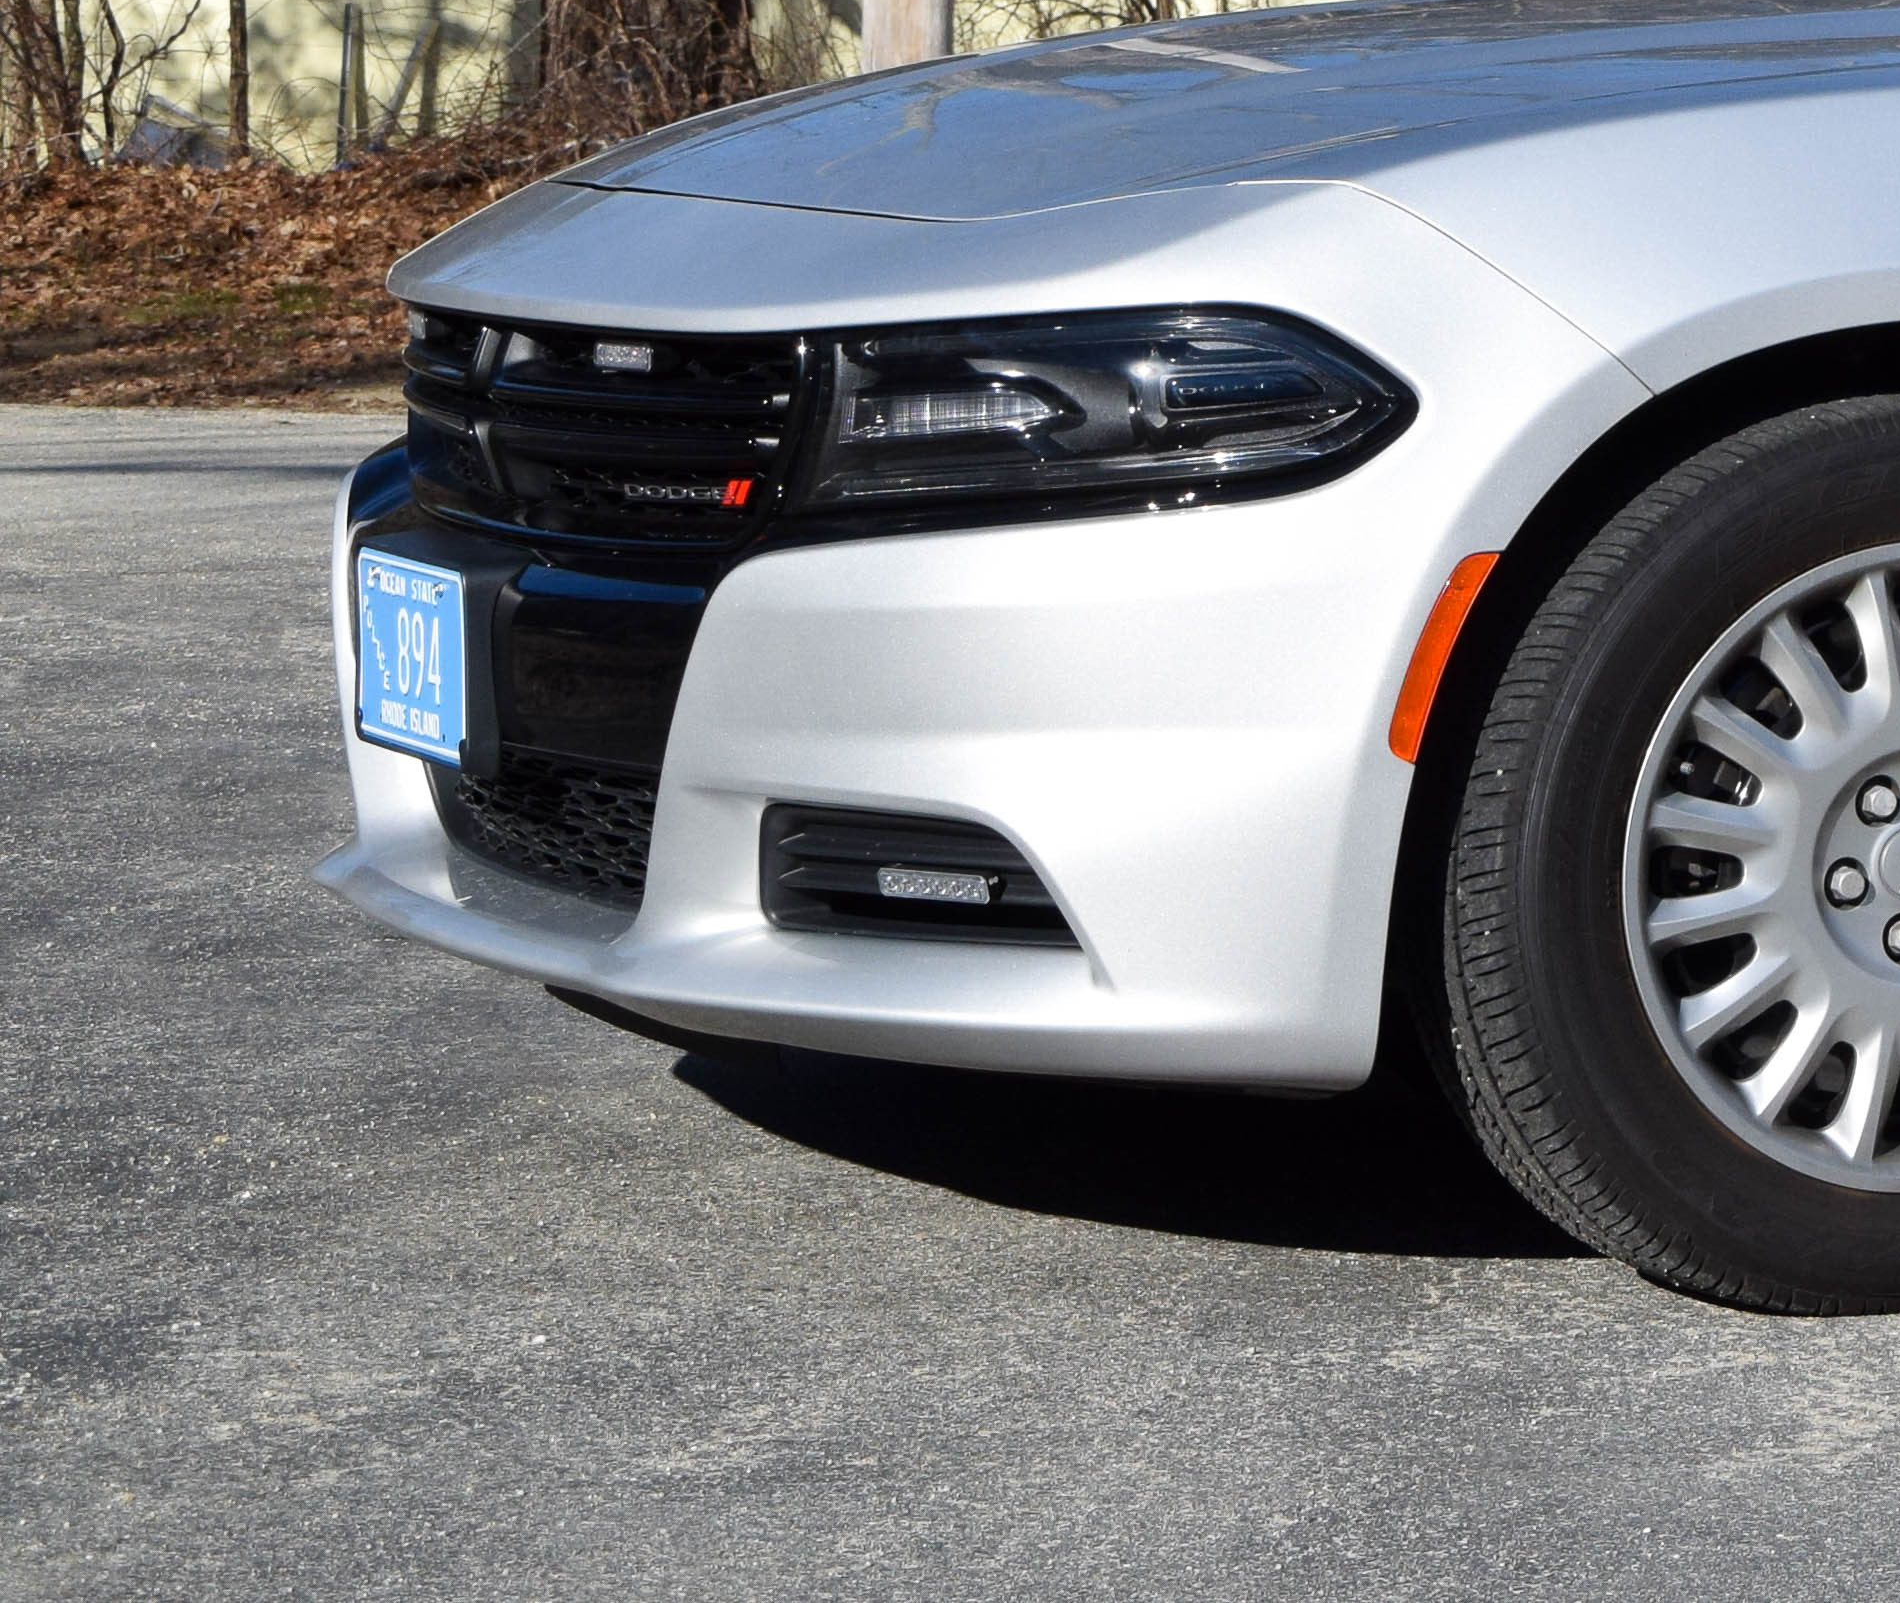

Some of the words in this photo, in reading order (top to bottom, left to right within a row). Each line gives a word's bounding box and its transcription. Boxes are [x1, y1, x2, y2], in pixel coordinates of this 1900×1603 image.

[624, 483, 730, 500] DODGE
[379, 567, 406, 597] OCEAN
[411, 579, 438, 606] STATE
[363, 595, 391, 691] POLICE
[397, 607, 441, 705] 894
[381, 698, 407, 730] RHODE
[409, 712, 440, 741] ISLAND
